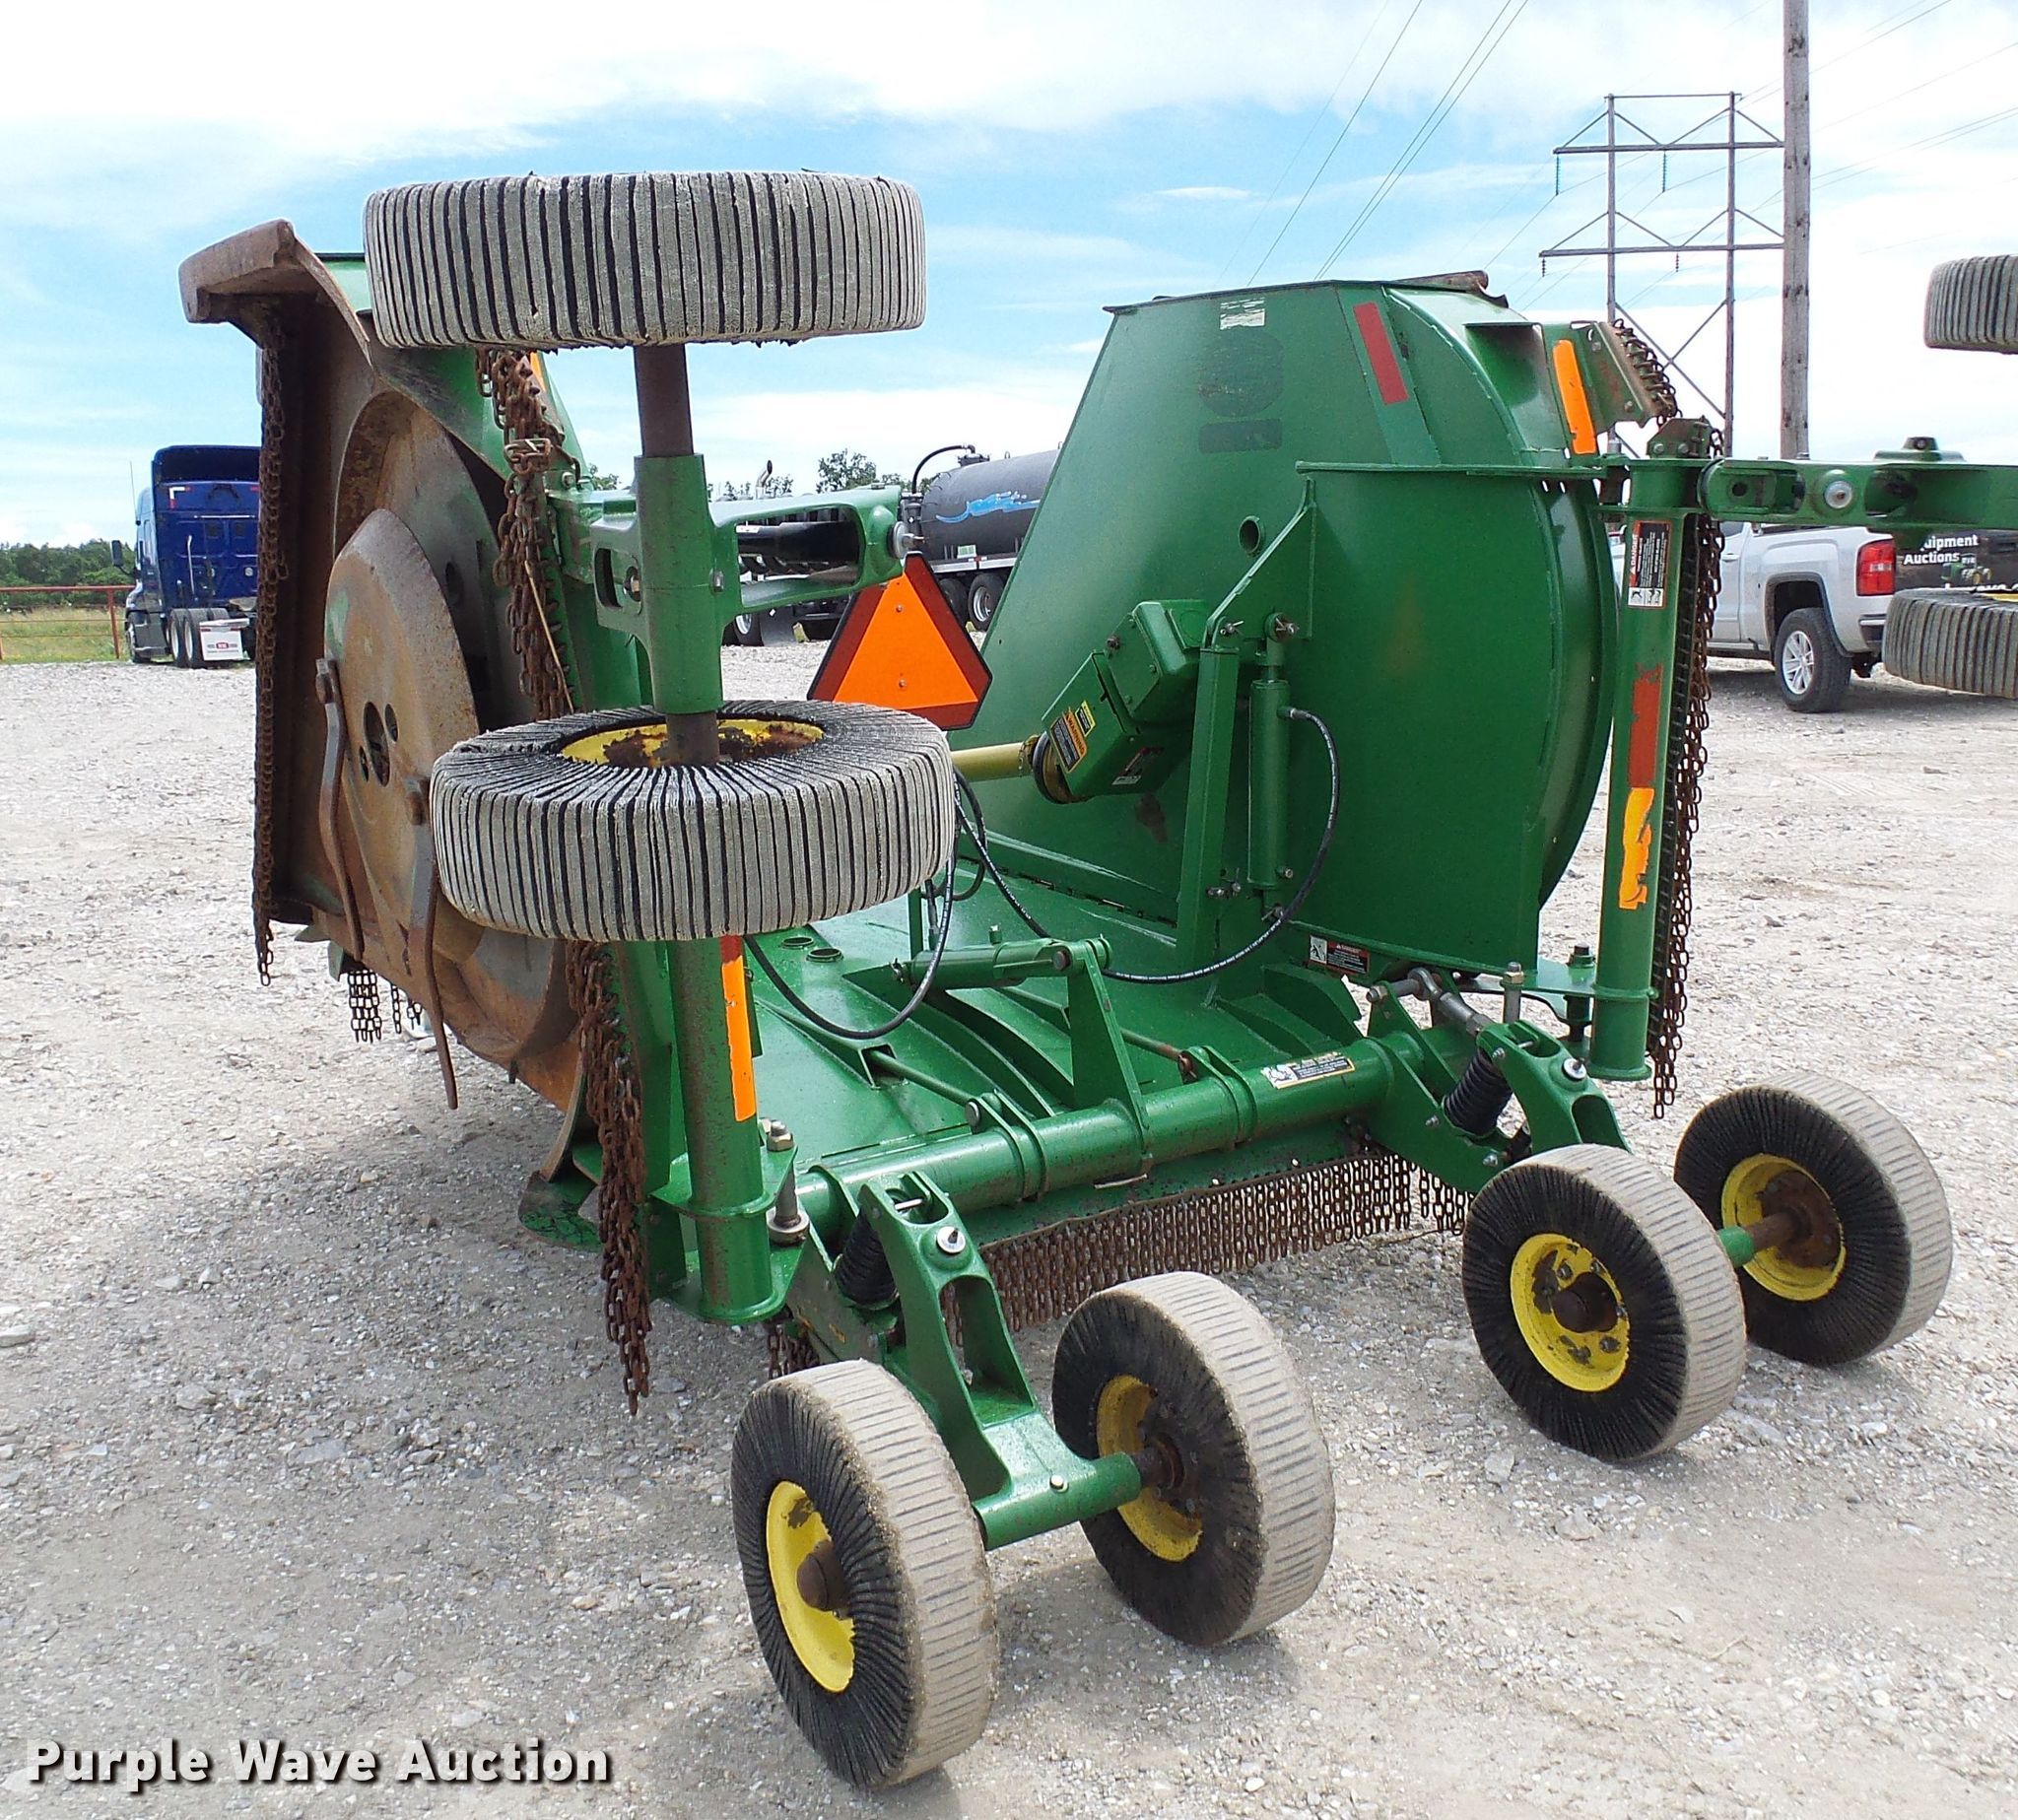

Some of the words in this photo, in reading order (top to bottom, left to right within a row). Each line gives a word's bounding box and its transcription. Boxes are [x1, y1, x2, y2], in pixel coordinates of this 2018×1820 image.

[1919, 534, 1980, 551] uipment
[1904, 551, 1960, 565] Auctions
[1068, 717, 1085, 755] WARNING
